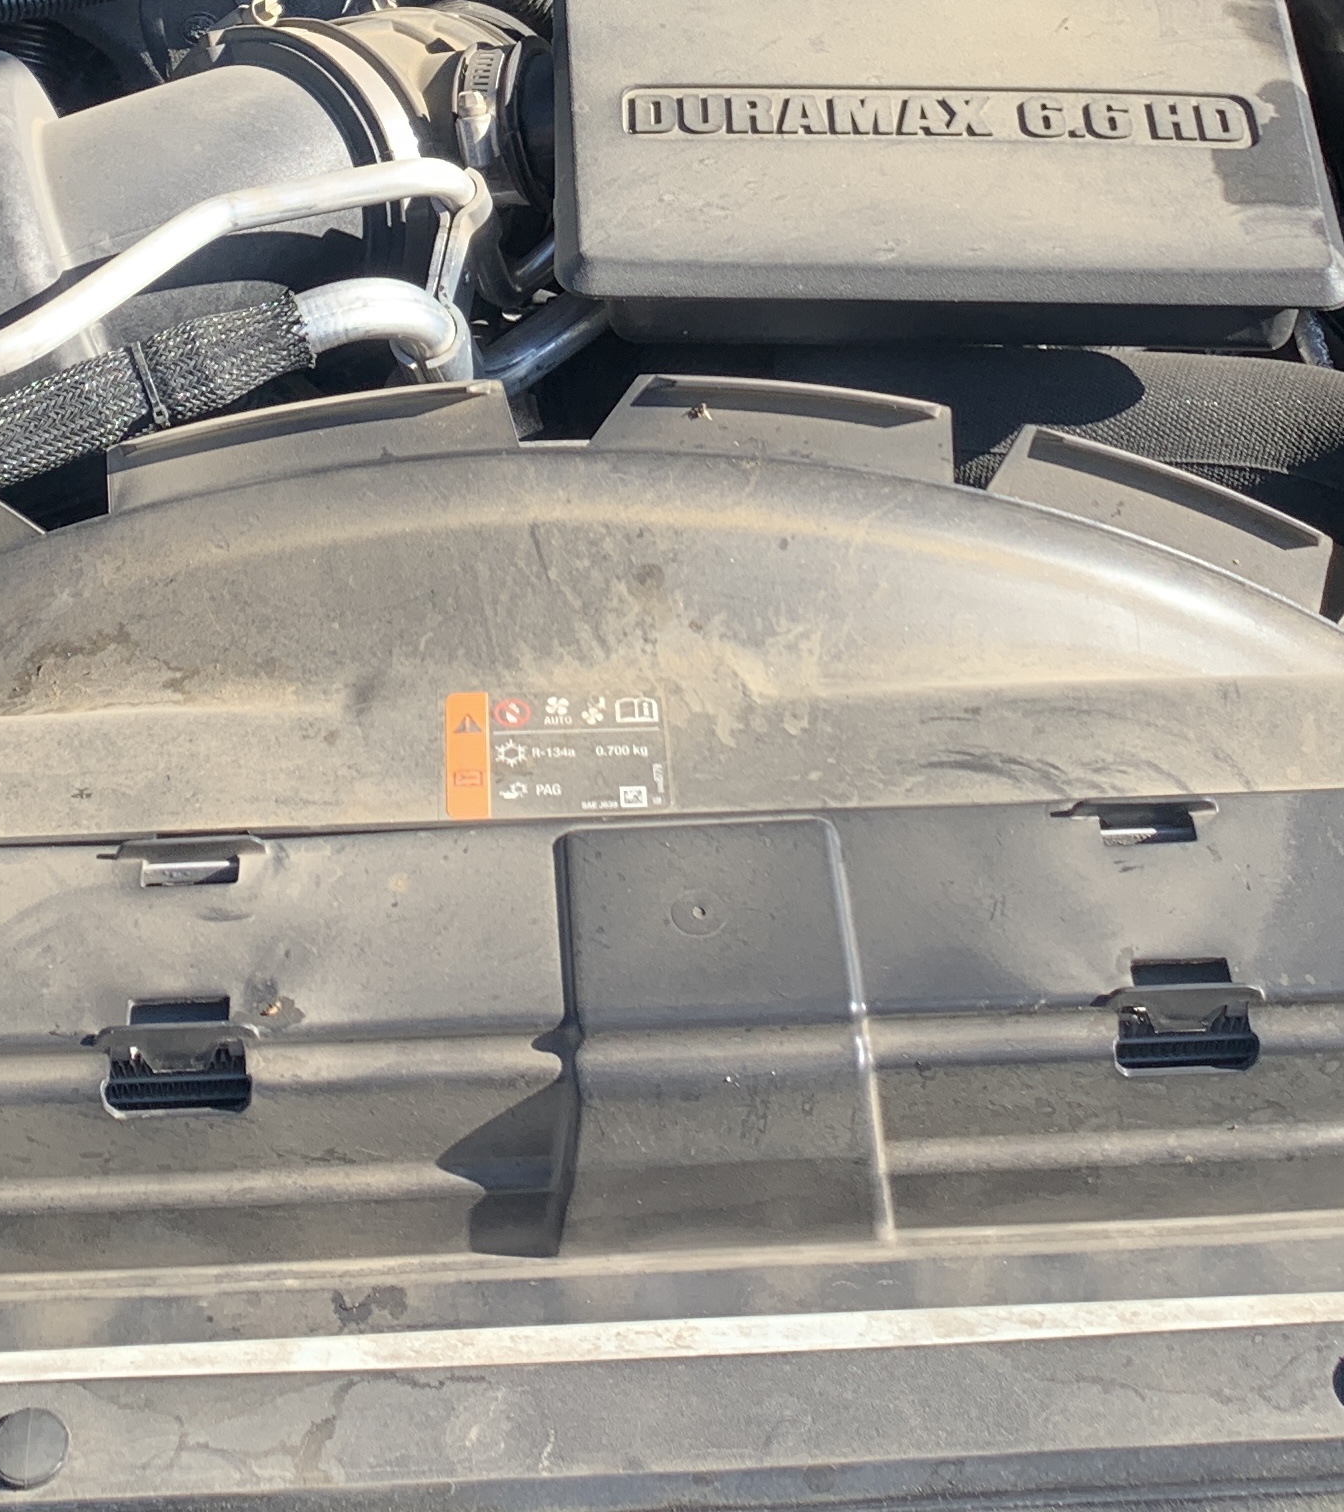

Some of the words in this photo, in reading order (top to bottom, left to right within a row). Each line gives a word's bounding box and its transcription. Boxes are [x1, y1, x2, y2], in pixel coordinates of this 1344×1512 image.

[627, 91, 993, 138] DURAMAX
[1017, 96, 1134, 140] 6.6
[1144, 100, 1248, 144] HD
[543, 714, 573, 726] AUTO
[532, 745, 576, 759] R-134a
[595, 745, 630, 757] 0.700
[632, 743, 649, 758] kg
[535, 783, 562, 797] PAG
